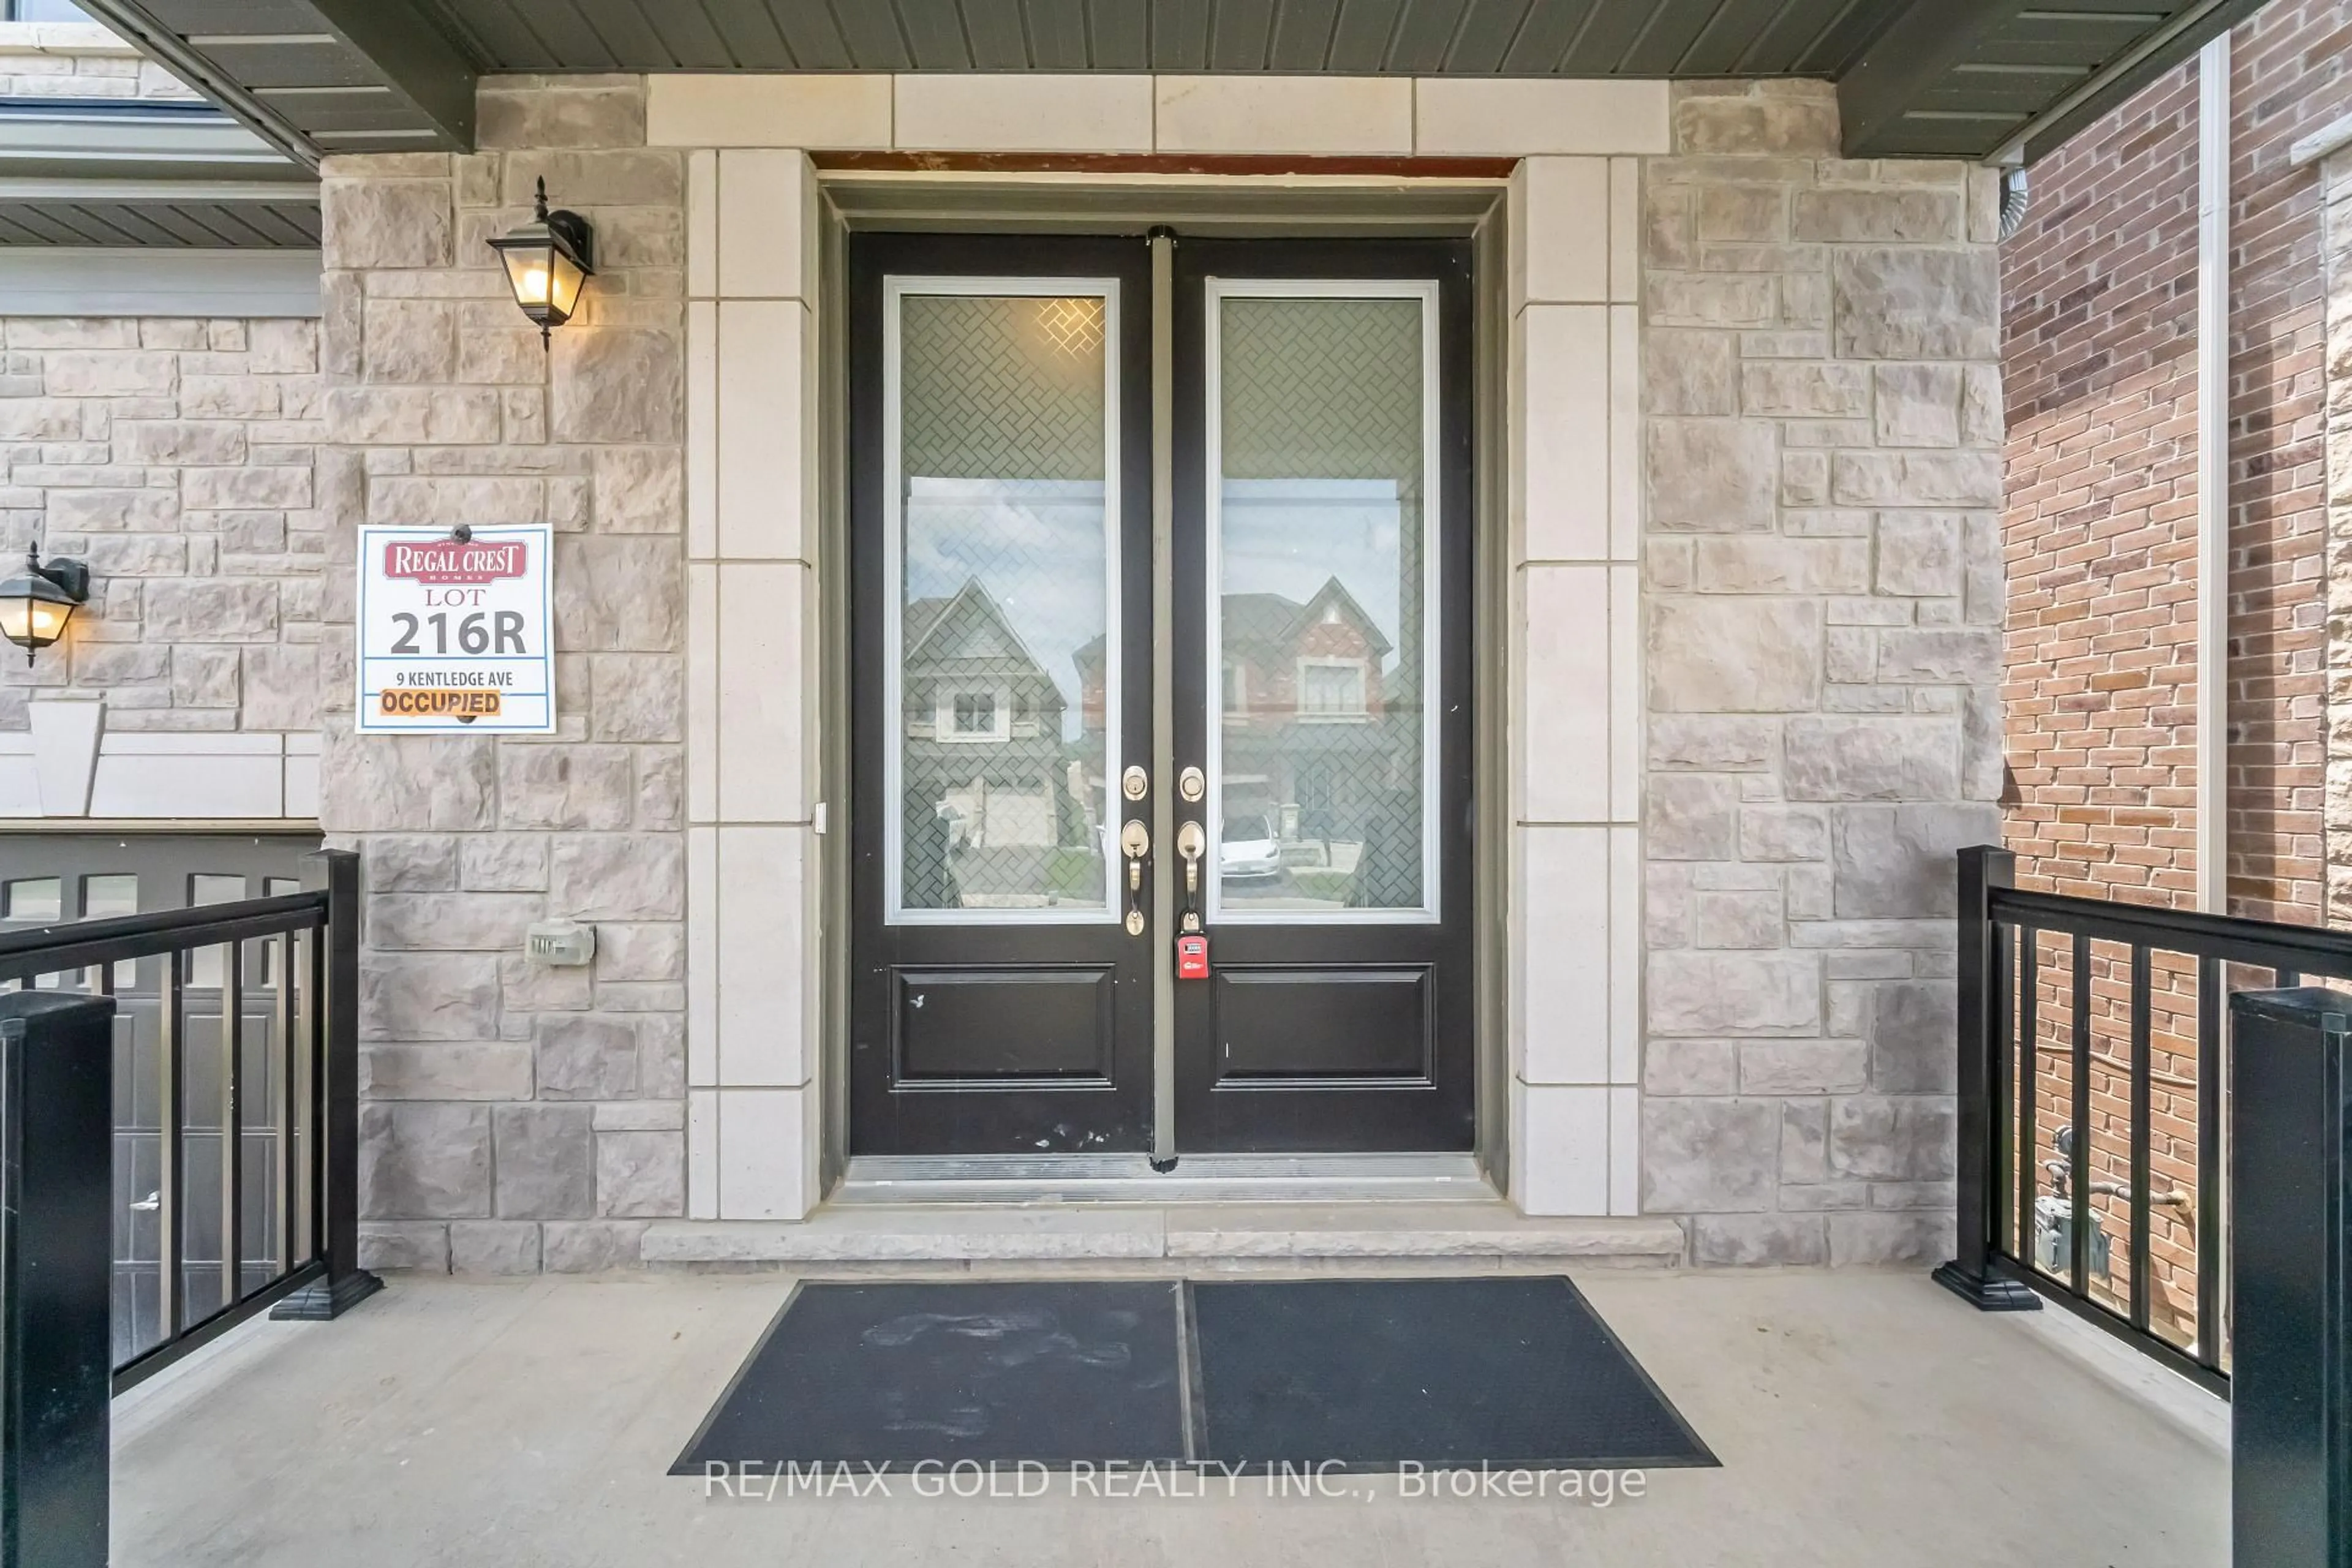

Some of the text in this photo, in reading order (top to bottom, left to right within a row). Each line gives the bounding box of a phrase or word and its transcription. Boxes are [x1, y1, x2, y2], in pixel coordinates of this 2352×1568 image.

[396, 546, 519, 573] REGAL CREST
[425, 589, 486, 606] LOT
[391, 611, 526, 654] 216R
[396, 671, 513, 686] 9 KENTLEDGE AVE
[382, 692, 499, 713] OCCUPIED
